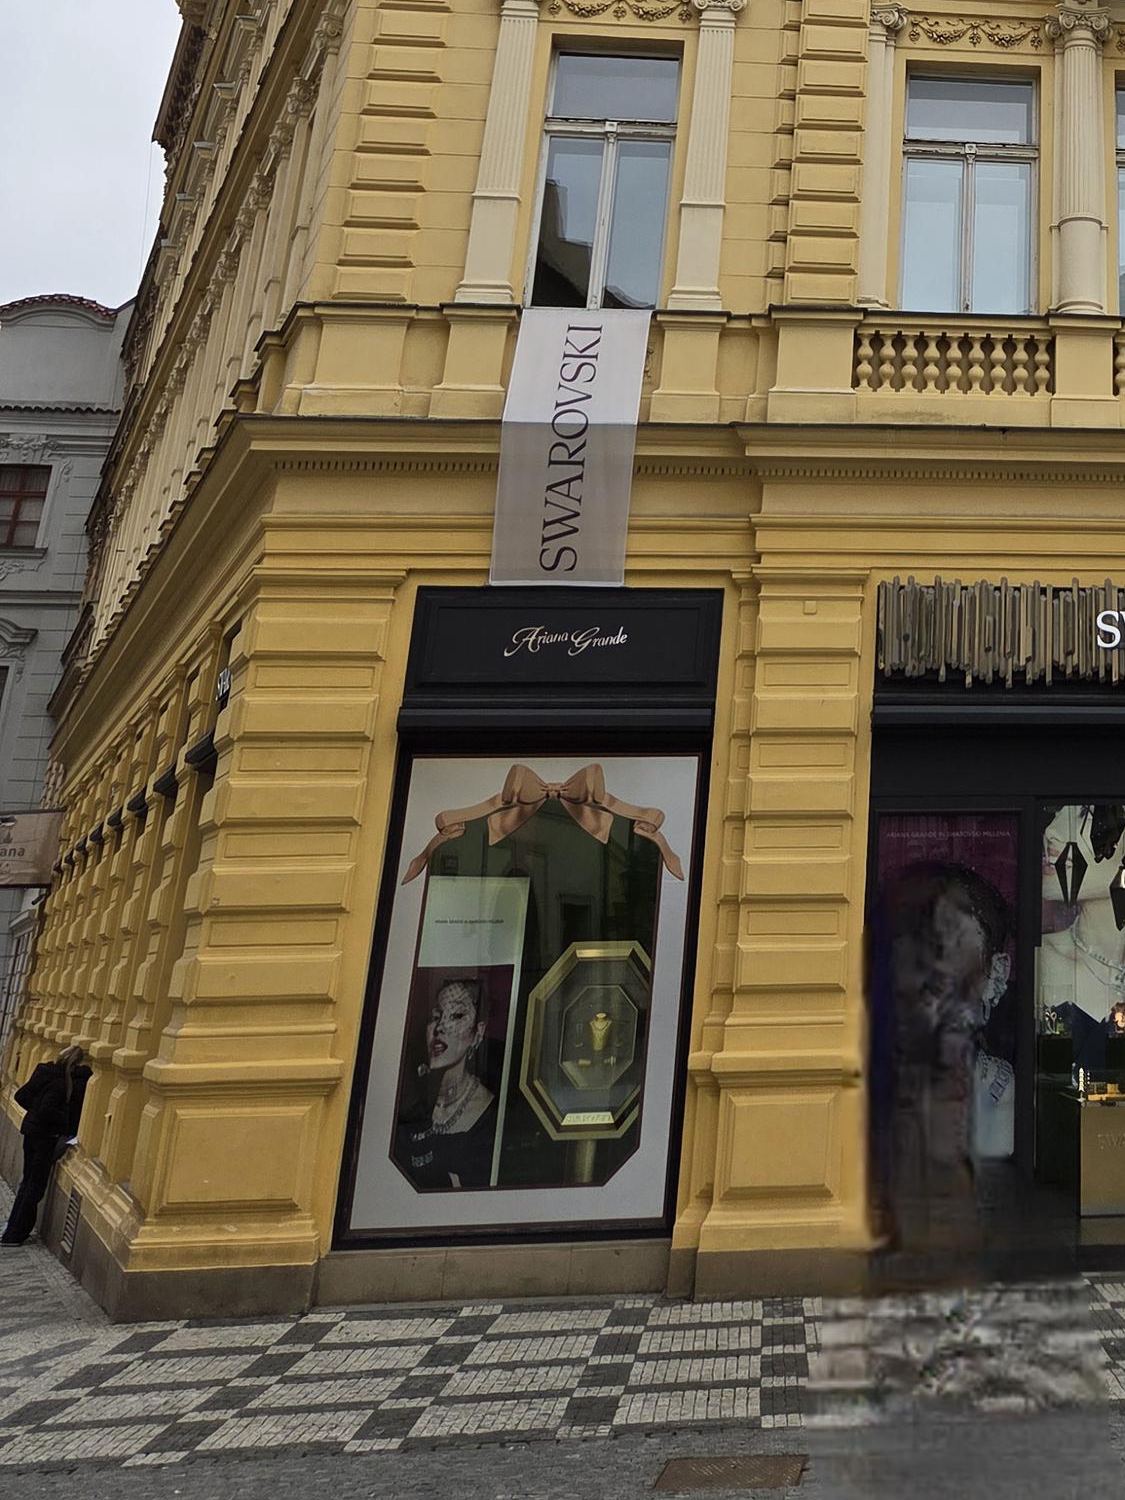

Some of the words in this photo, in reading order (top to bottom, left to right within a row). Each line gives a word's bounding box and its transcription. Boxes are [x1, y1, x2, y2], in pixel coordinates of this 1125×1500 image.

[538, 323, 603, 572] SWAROVSKI
[503, 625, 569, 657] Ariana
[567, 626, 628, 657] Grande
